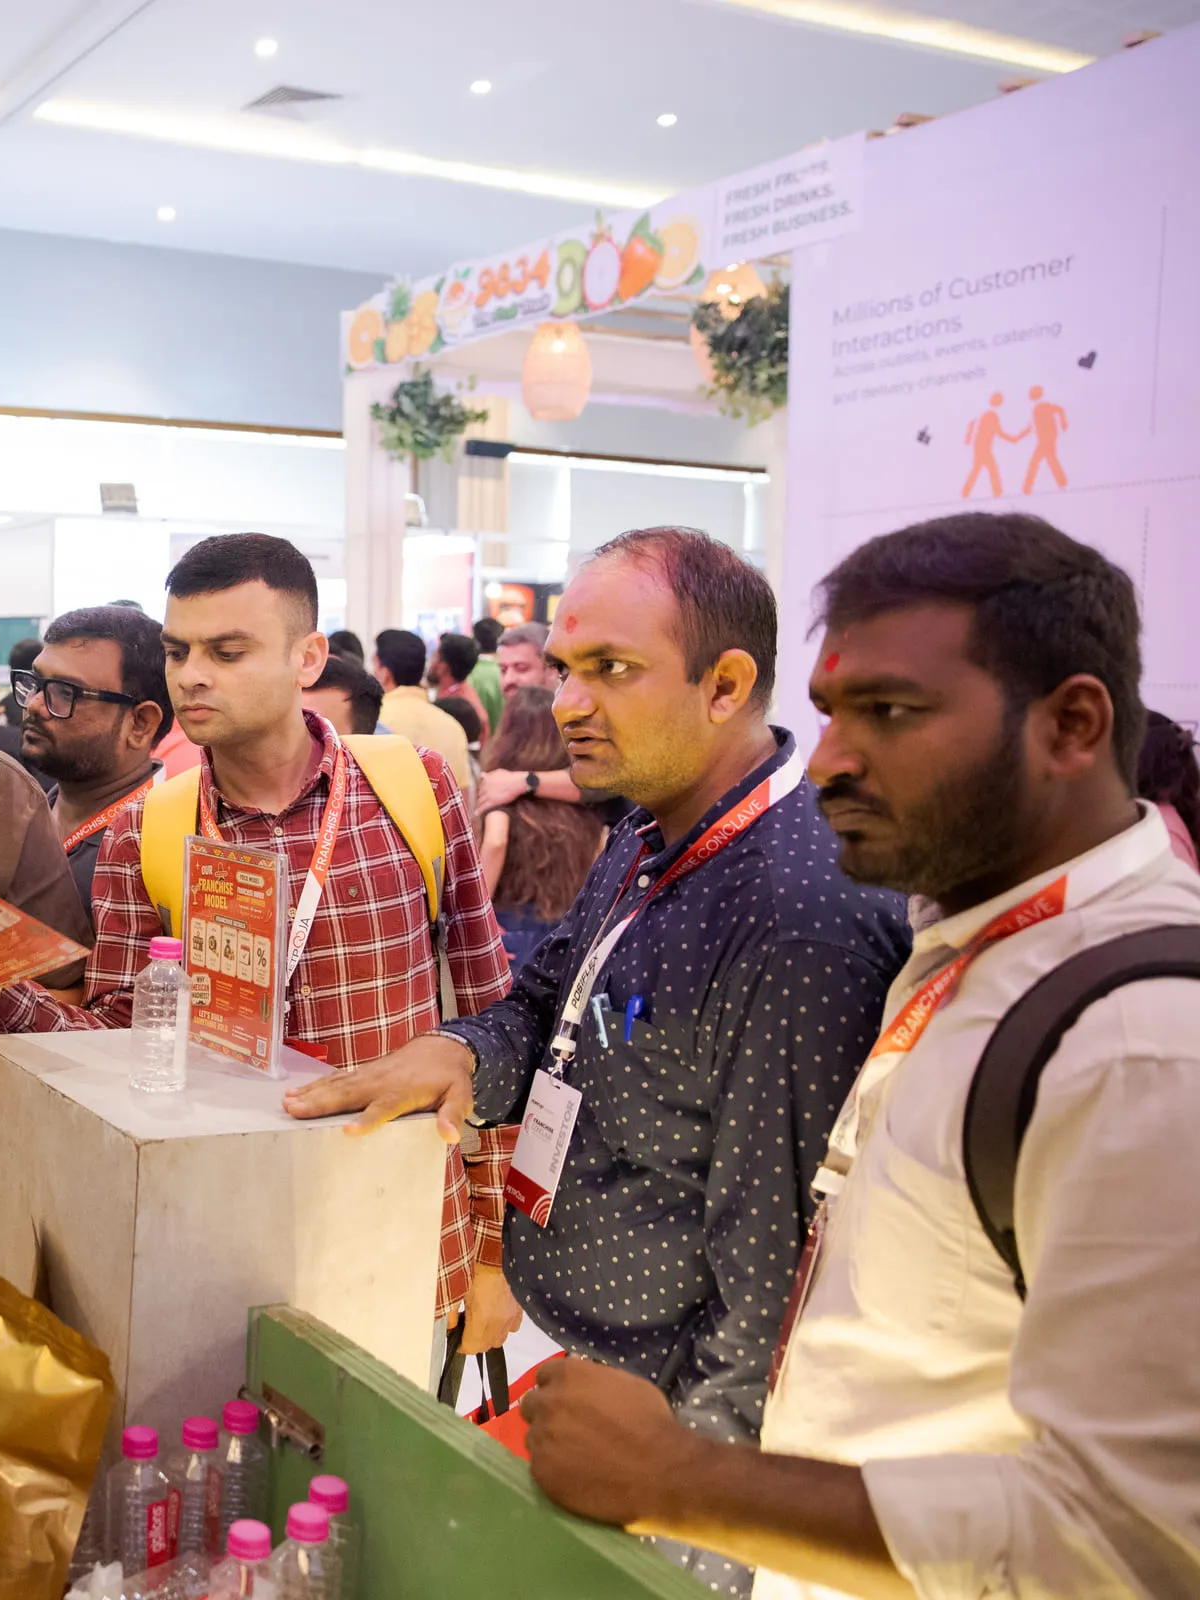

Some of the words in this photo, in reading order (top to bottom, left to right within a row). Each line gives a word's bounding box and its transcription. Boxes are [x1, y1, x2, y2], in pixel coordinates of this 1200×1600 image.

[725, 179, 772, 206] FRESH
[722, 223, 769, 249] FRESH
[772, 200, 855, 235] BUSINESS.
[724, 200, 770, 227] FRESH
[832, 293, 914, 326] Millions
[918, 280, 943, 308] of
[948, 254, 1075, 300] Customer
[831, 314, 963, 357] Interactions
[992, 321, 1063, 347] catering
[916, 365, 988, 389] channels
[63, 815, 109, 849] FRANCHISE
[315, 809, 339, 872] FRANCHISE
[696, 799, 764, 859] CONCLAVE
[198, 877, 234, 896] FRANCHISE
[201, 864, 213, 876] OUR
[204, 893, 228, 910] MODEL
[571, 952, 598, 1009] POSIFLEX
[549, 1100, 575, 1174] INVESTOR
